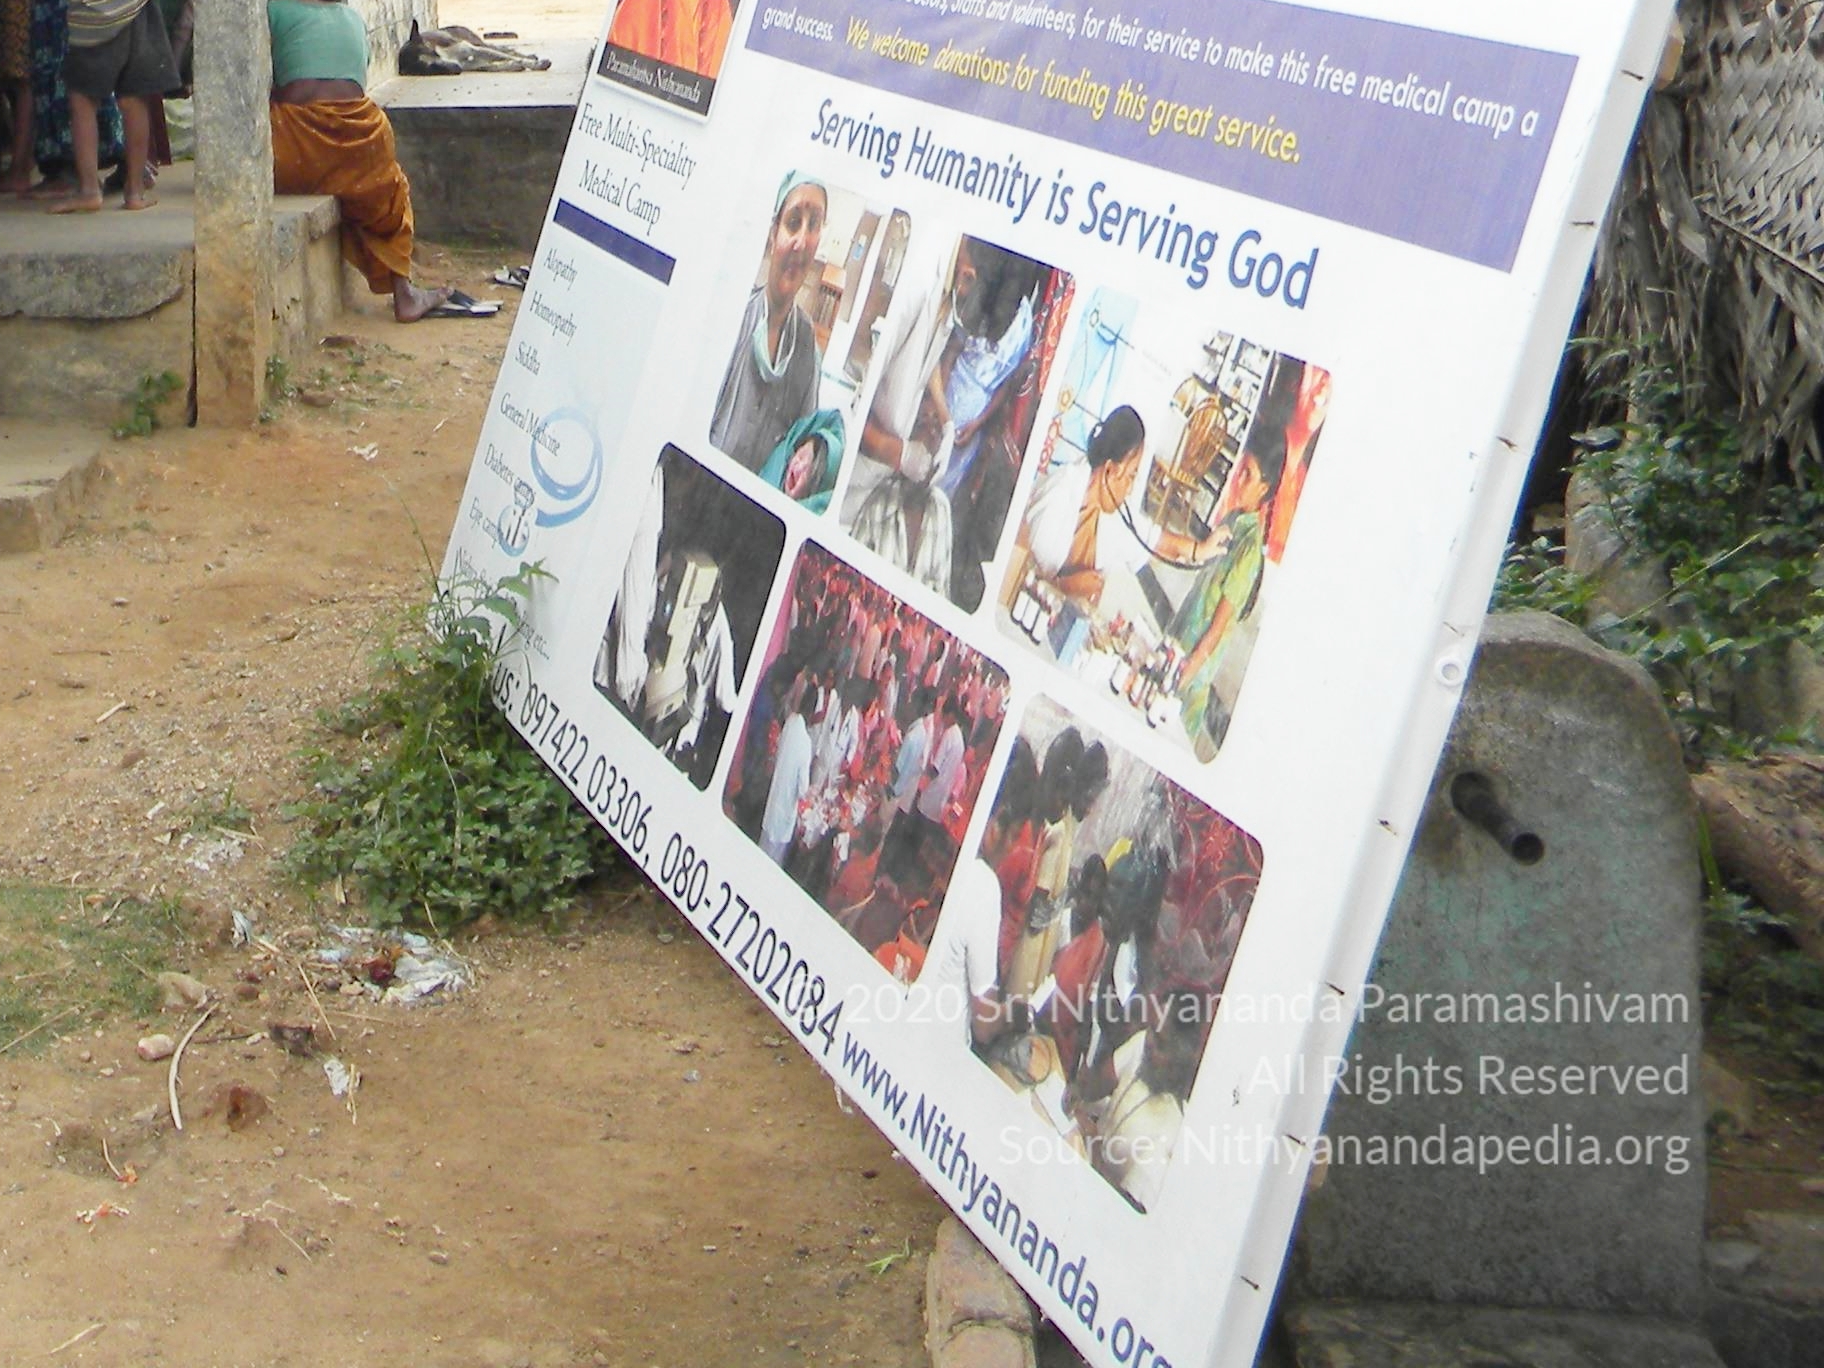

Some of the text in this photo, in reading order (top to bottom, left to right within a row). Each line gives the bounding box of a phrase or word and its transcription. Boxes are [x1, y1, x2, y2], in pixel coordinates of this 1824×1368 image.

[761, 6, 1302, 163] grand success. We welcome donations for funding this great service.
[1080, 6, 1105, 39] for
[1106, 14, 1143, 48] their
[1143, 23, 1201, 62] service
[1202, 35, 1223, 67] to
[1224, 41, 1275, 78] make
[1276, 48, 1311, 85] this
[1312, 53, 1356, 96] free
[1360, 72, 1451, 117] medical
[1451, 94, 1515, 140] camp
[1519, 109, 1540, 137] a
[578, 102, 698, 190] Free Multi-Speciality
[578, 159, 662, 236] Medical Camp
[810, 97, 1321, 311] Serving Humanity is Serving God
[519, 682, 589, 786] 097422
[587, 754, 653, 870] 03306,
[660, 832, 845, 1057] 080-27202084
[843, 1031, 1173, 1368] www.Nithyananda.or
